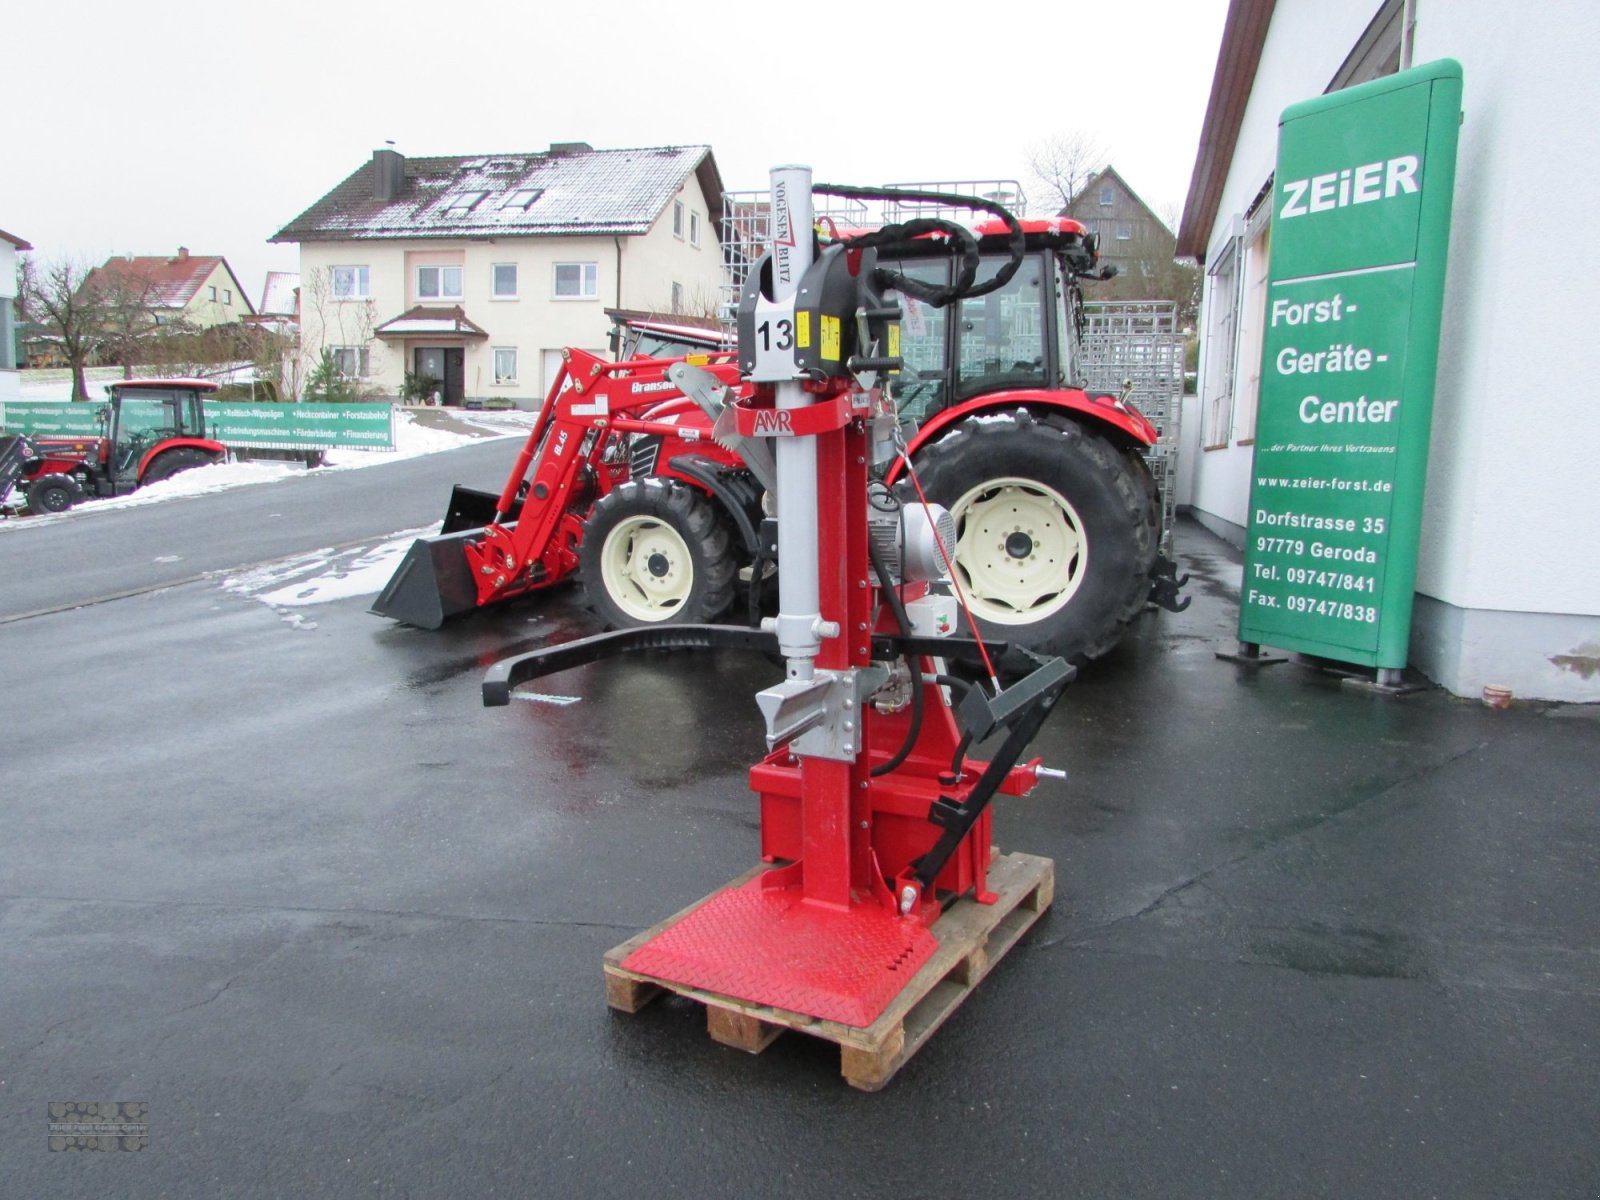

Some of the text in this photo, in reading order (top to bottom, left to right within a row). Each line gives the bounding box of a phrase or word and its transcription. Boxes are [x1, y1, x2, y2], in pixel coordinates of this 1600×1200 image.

[775, 181, 791, 284] VOGESEN BLITZ
[758, 319, 794, 351] 13
[632, 381, 676, 394] Branson
[753, 410, 793, 433] AMR
[1299, 395, 1399, 424] Center
[1286, 444, 1319, 453] Partner
[1320, 444, 1343, 453] Ihres
[1345, 444, 1395, 454] Vertrauens
[1257, 476, 1392, 493] www.zeier-forst.de
[1256, 510, 1385, 534] Dorfstrasse 35
[1256, 537, 1377, 563] 97779 Geroda
[1253, 563, 1375, 593] Tel. 09747/841
[1248, 590, 1377, 623] Fax. 09747/838
